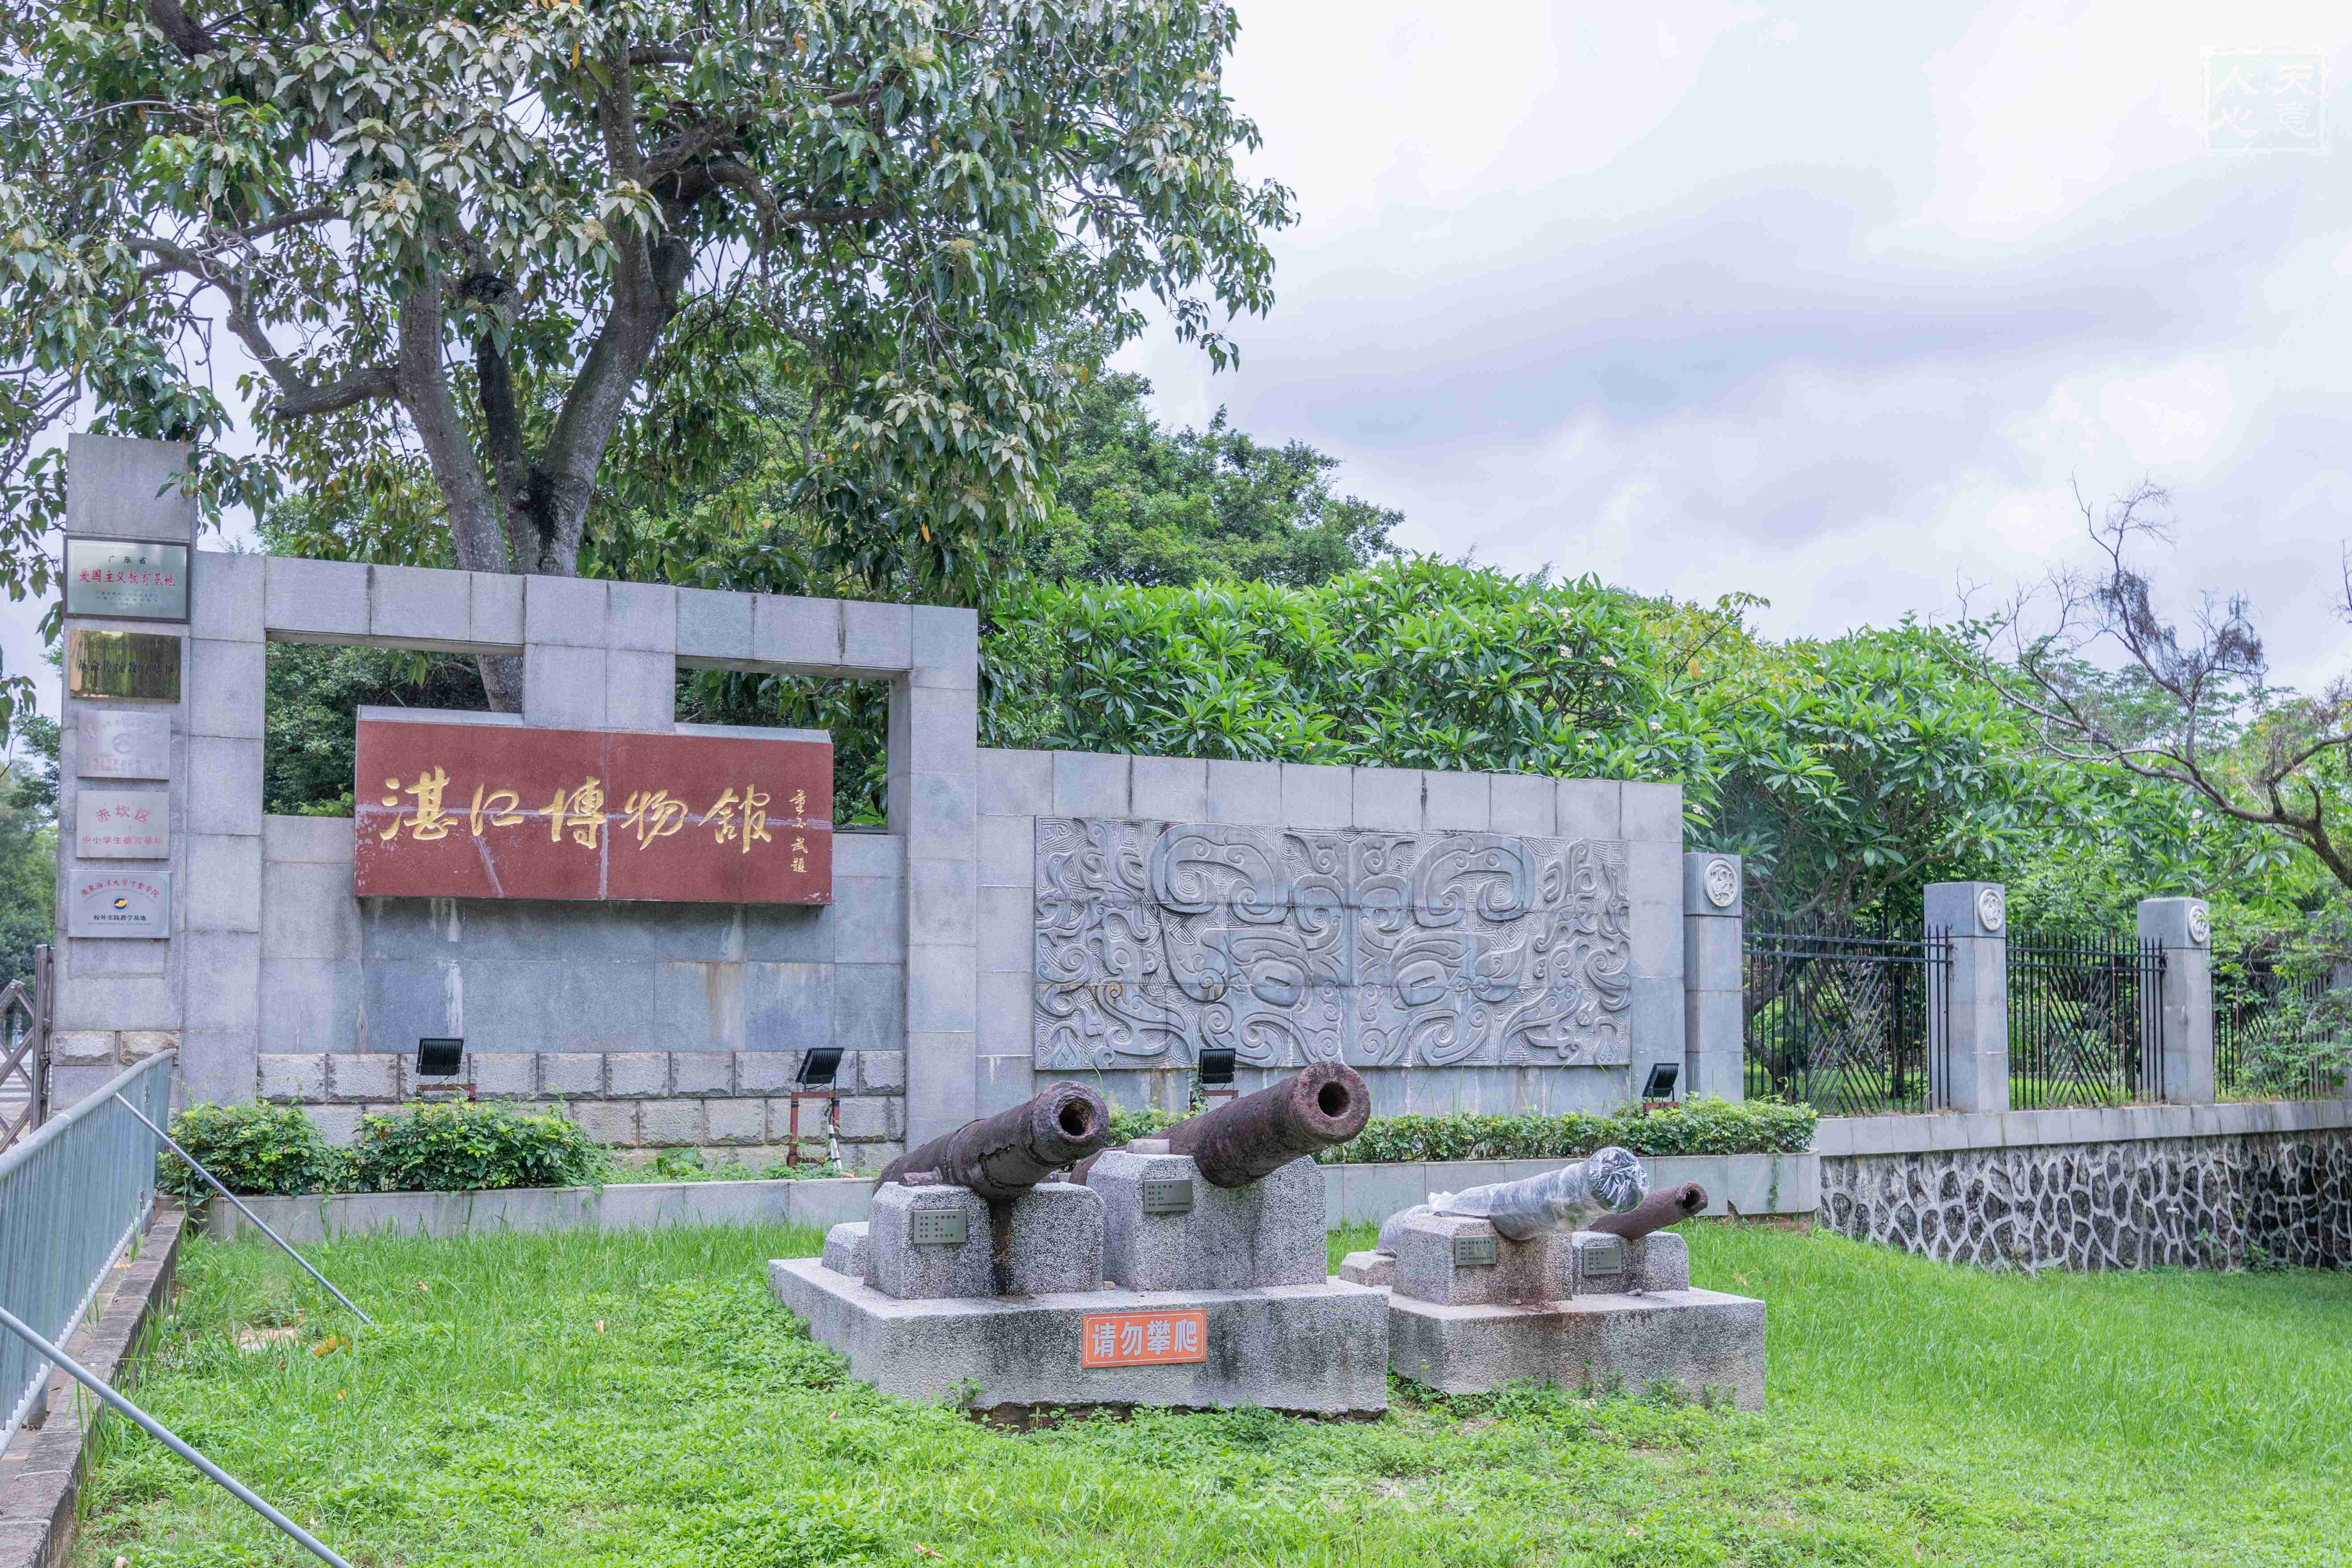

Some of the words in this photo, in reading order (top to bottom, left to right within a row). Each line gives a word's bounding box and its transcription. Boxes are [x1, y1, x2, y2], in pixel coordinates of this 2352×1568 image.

[108, 555, 147, 565] 广东省
[78, 567, 176, 586] 爱国主义教育基地
[96, 805, 151, 824] 赤坎区
[1092, 1318, 1198, 1358] 请勿攀爬
